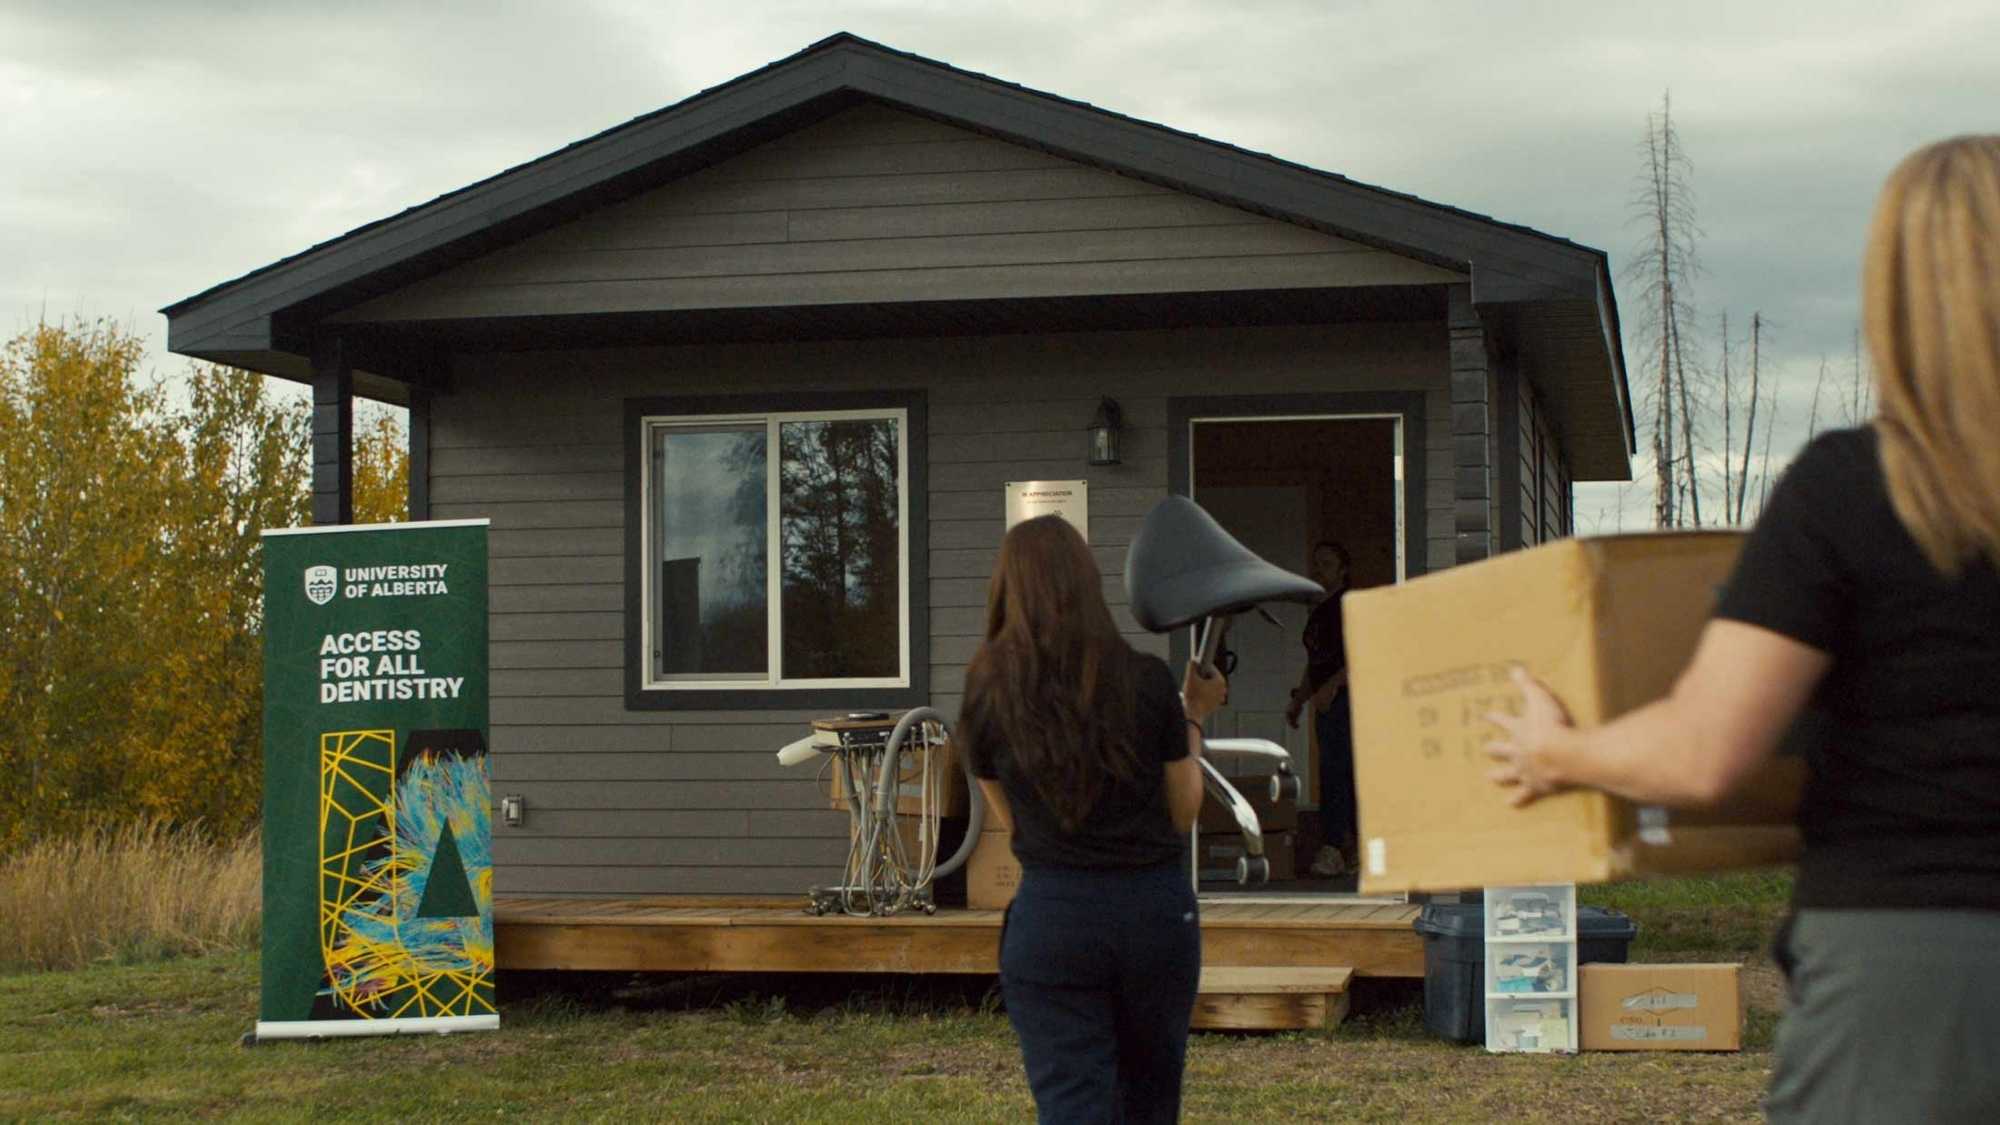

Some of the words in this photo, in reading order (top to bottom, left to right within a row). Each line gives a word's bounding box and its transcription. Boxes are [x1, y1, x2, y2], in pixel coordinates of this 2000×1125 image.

[344, 563, 448, 582] UNIVERSITY
[344, 584, 368, 598] OF
[371, 580, 448, 597] ALBERTA
[320, 629, 421, 656] ACCESS
[320, 656, 371, 679] FOR
[375, 654, 425, 676] ALL
[320, 677, 464, 704] DENTISTRY
